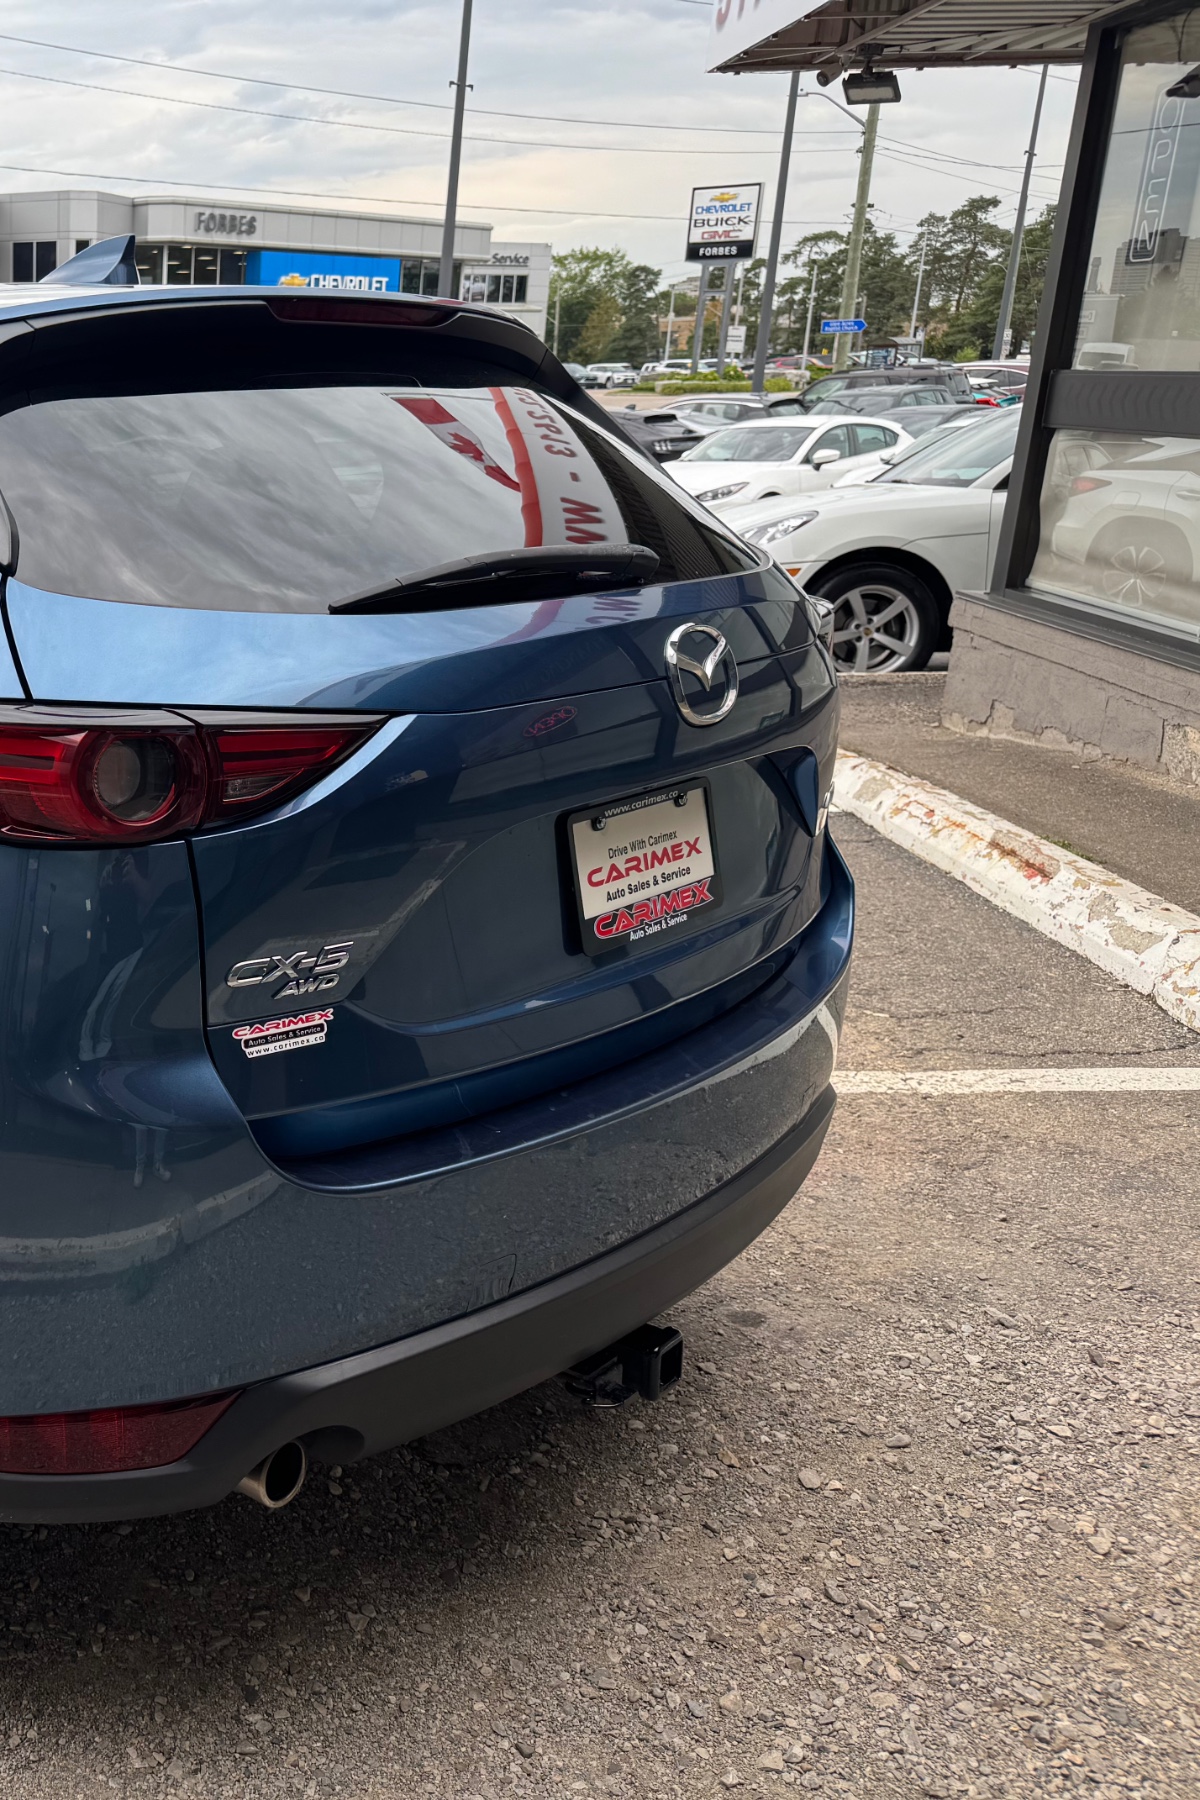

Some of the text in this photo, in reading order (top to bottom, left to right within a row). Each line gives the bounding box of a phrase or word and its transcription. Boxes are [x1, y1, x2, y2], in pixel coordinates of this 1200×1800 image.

[1136, 96, 1180, 252] OPEN
[693, 215, 751, 228] BUICK
[695, 202, 753, 215] CHEVROLET
[194, 211, 257, 236] FORBES
[701, 229, 742, 240] GMC
[492, 252, 529, 264] Service
[699, 246, 737, 256] FORBES
[310, 273, 389, 292] CHEVROLET
[604, 790, 679, 817] www.carimex.ca
[608, 830, 678, 859] Drive With Carimex
[587, 836, 703, 888] CARIMEX
[606, 866, 691, 902] Auto Sales & Service
[594, 878, 714, 939] CARIMEX
[630, 913, 688, 941] Auto Sales & Service
[226, 941, 354, 987] CX-5
[273, 973, 340, 1000] AWD
[233, 1009, 333, 1038] CARIMEX
[248, 1037, 266, 1047] Auto
[267, 1032, 287, 1043] Sales
[296, 1026, 321, 1037] Service
[247, 1034, 325, 1057] www.carimex.ca
